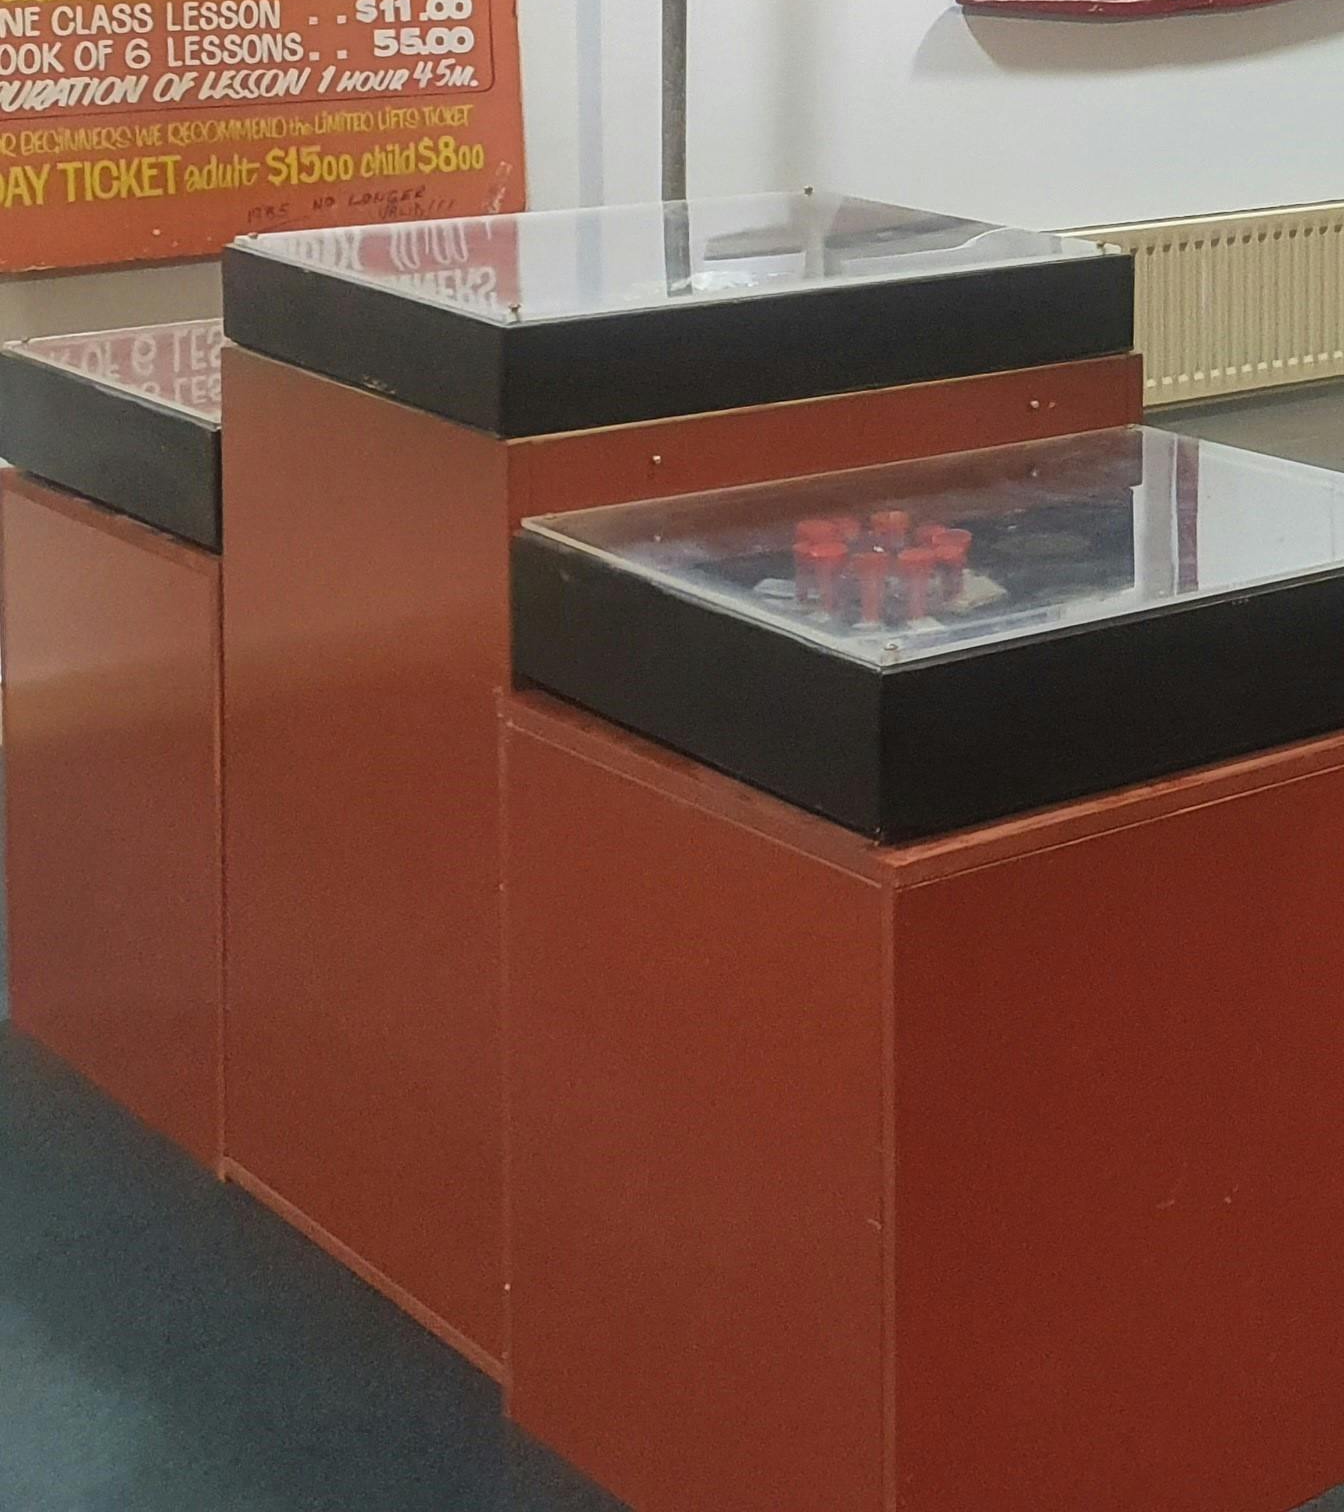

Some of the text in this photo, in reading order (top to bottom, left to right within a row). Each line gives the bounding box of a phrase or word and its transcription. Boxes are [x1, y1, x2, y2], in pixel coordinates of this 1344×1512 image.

[51, 2, 153, 36] CLASS
[166, 0, 281, 32] LESSON
[74, 40, 114, 74] OF
[124, 39, 151, 69] 6
[167, 32, 304, 66] LESSONS
[374, 26, 475, 58] 55.00
[153, 71, 199, 103] OF
[198, 67, 312, 101] LESSON
[316, 65, 338, 94] 1
[337, 69, 410, 92] HOUR
[135, 123, 163, 146] WE
[168, 116, 288, 145] RECOMMEND
[56, 155, 182, 202] TICKET
[184, 153, 260, 192] adult
[360, 141, 416, 177] child
